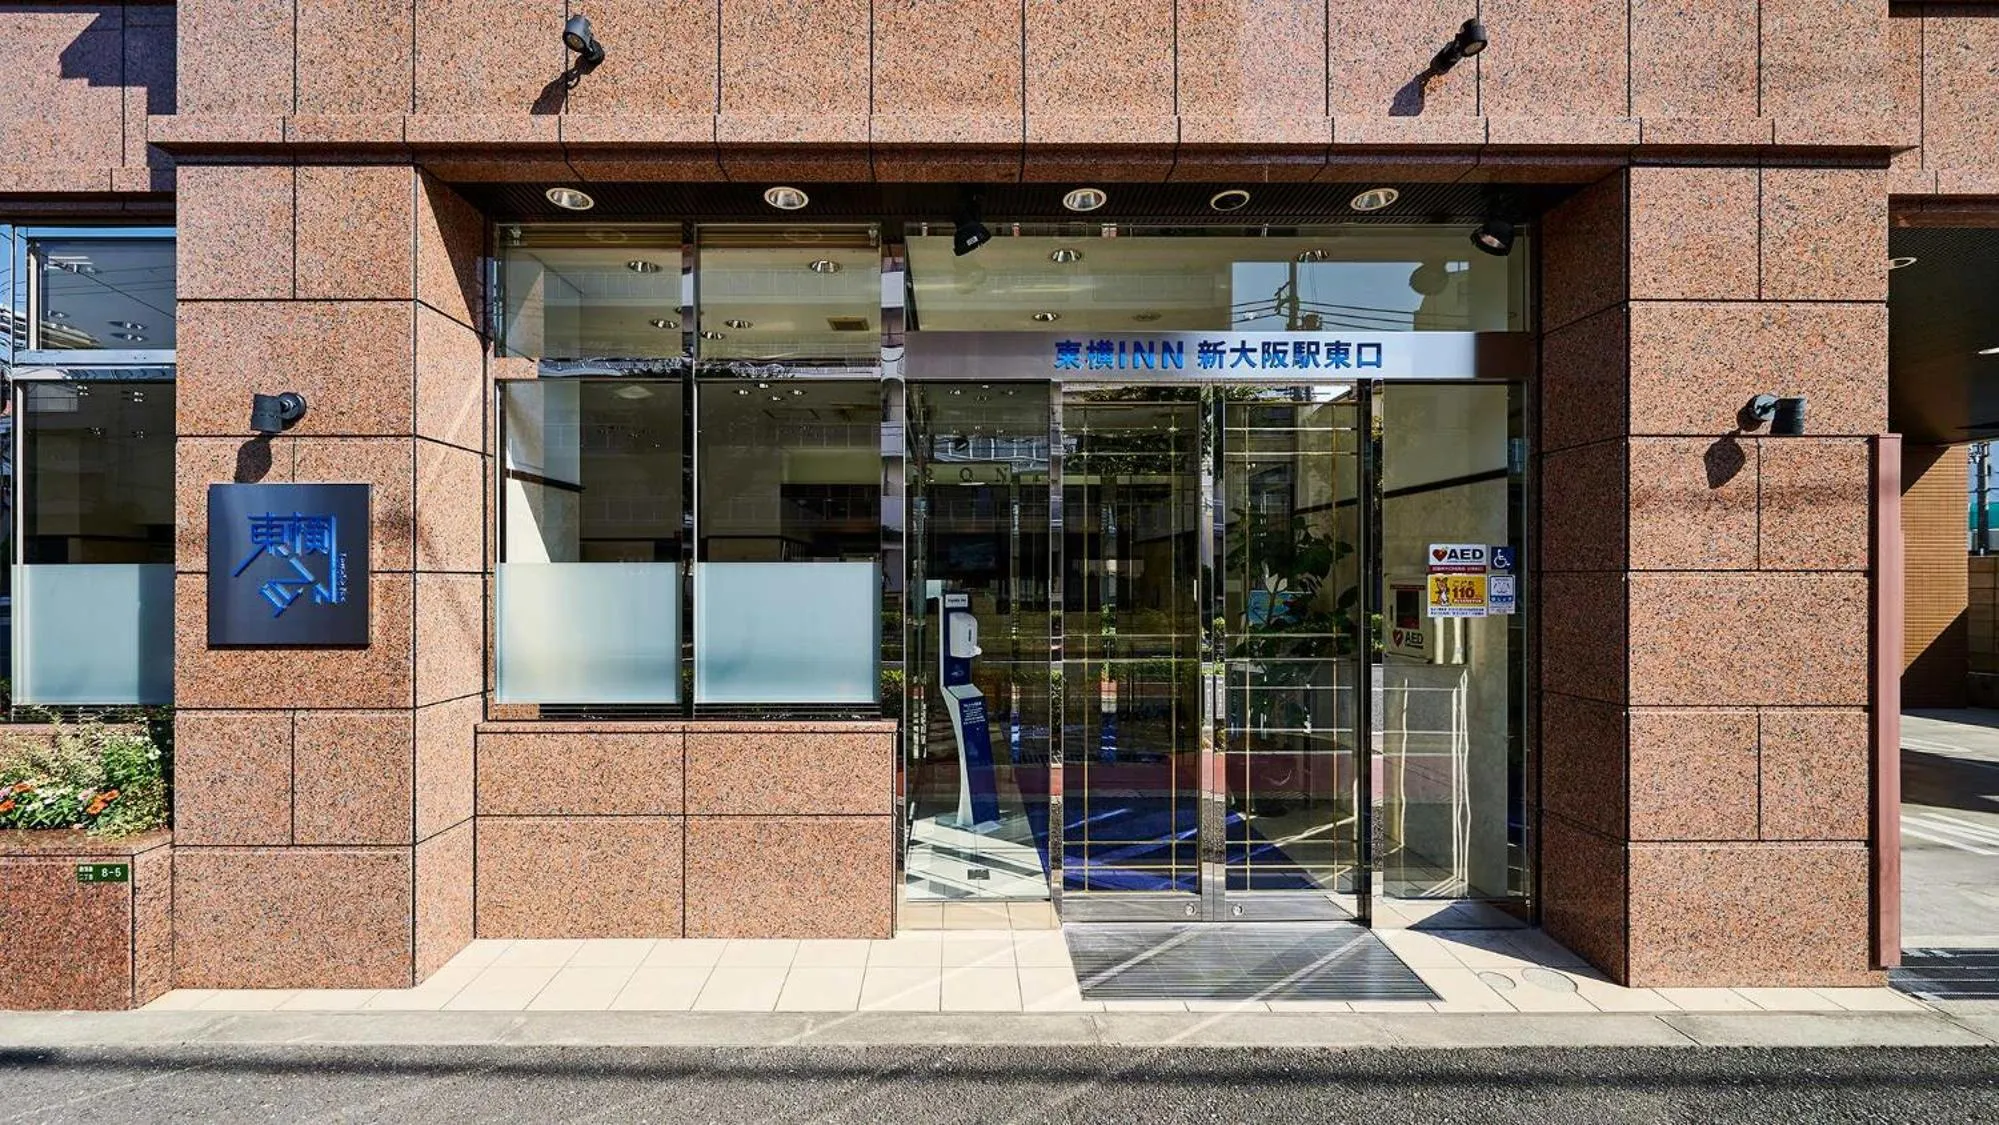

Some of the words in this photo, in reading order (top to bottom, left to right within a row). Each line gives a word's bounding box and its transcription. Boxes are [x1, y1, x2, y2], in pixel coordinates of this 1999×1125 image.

[1054, 340, 1185, 371] 東横INN
[1197, 340, 1383, 370] 新大阪駅東口
[1447, 548, 1484, 560] AED
[1452, 587, 1475, 598] 110
[1405, 631, 1424, 645] AED
[101, 867, 122, 878] 8-5
